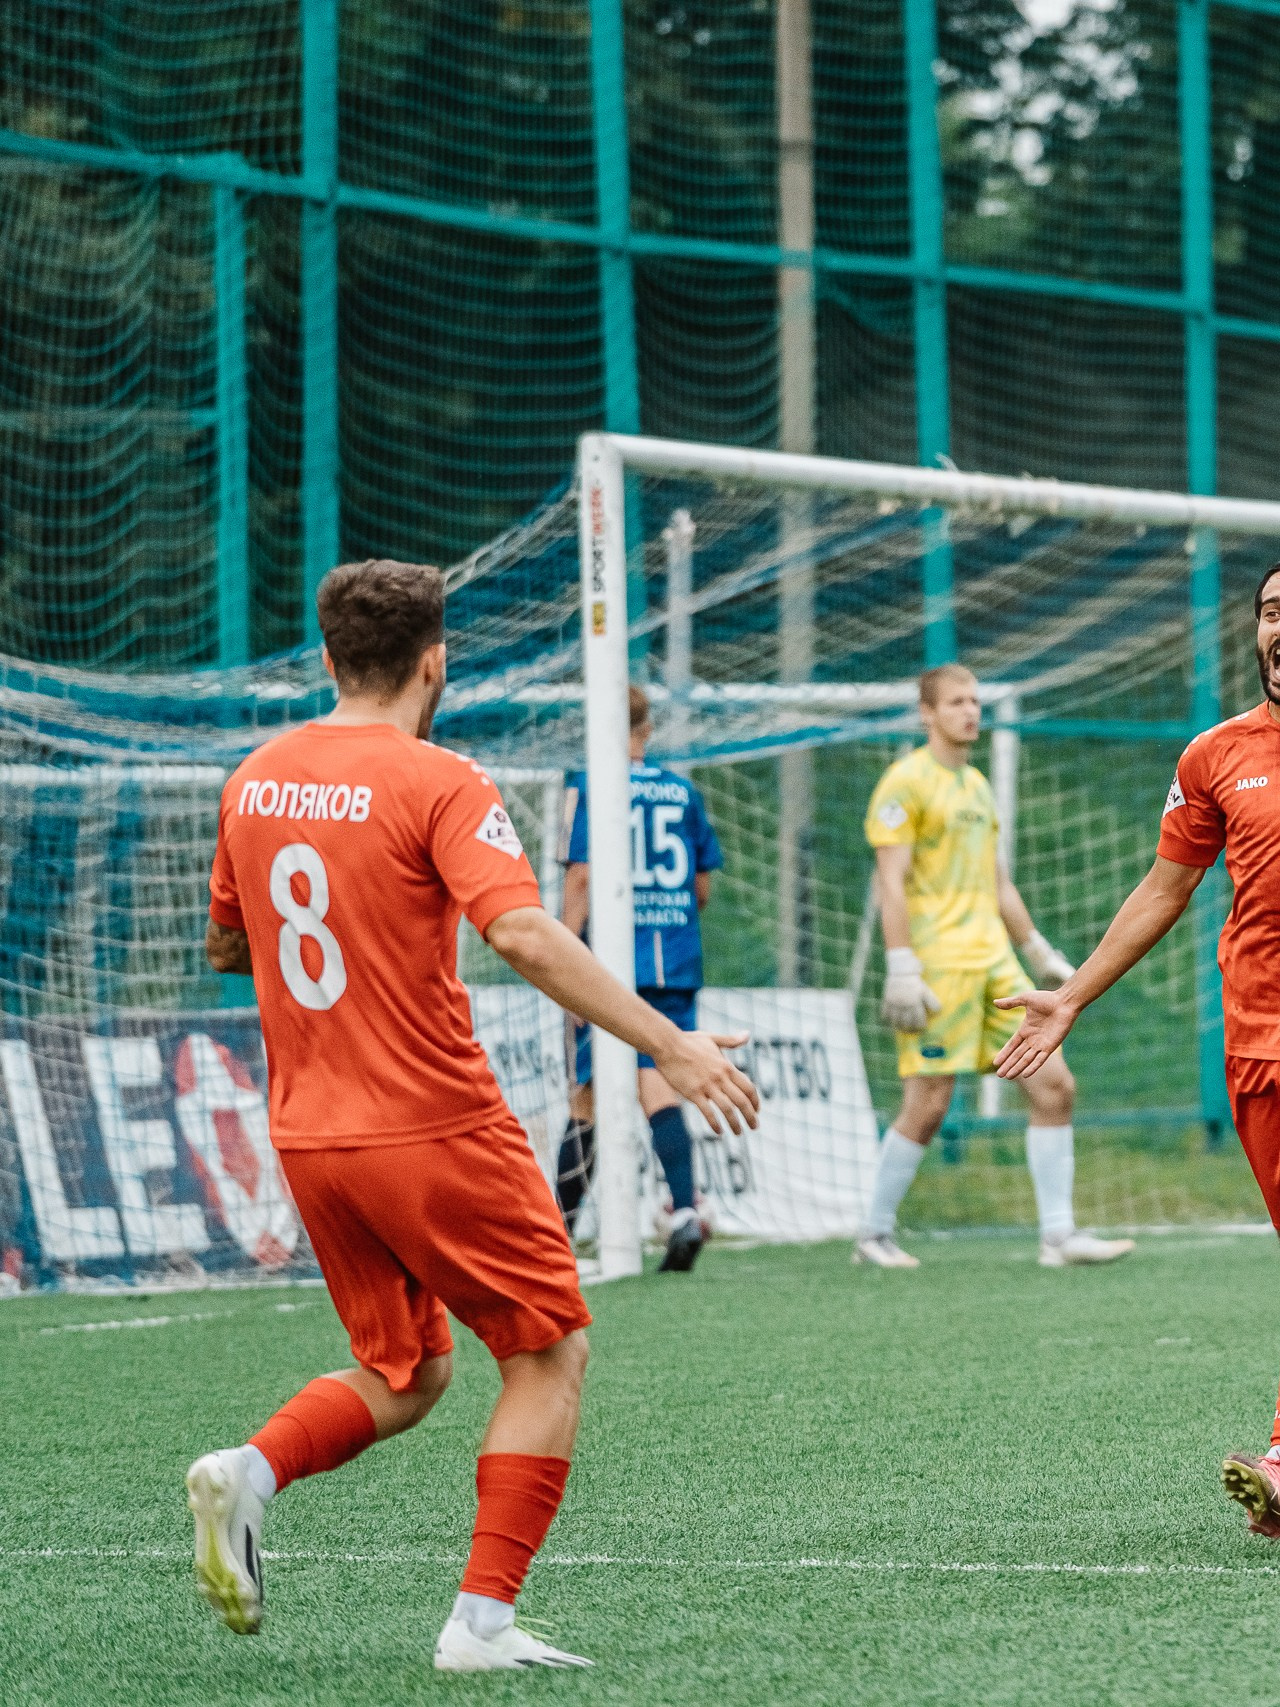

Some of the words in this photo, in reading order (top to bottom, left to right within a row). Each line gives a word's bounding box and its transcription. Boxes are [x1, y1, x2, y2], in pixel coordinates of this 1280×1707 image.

[238, 780, 372, 823] ПОЛЯКОВ
[1235, 776, 1268, 791] JAKO
[630, 803, 689, 889] 15
[269, 842, 347, 1011] 8
